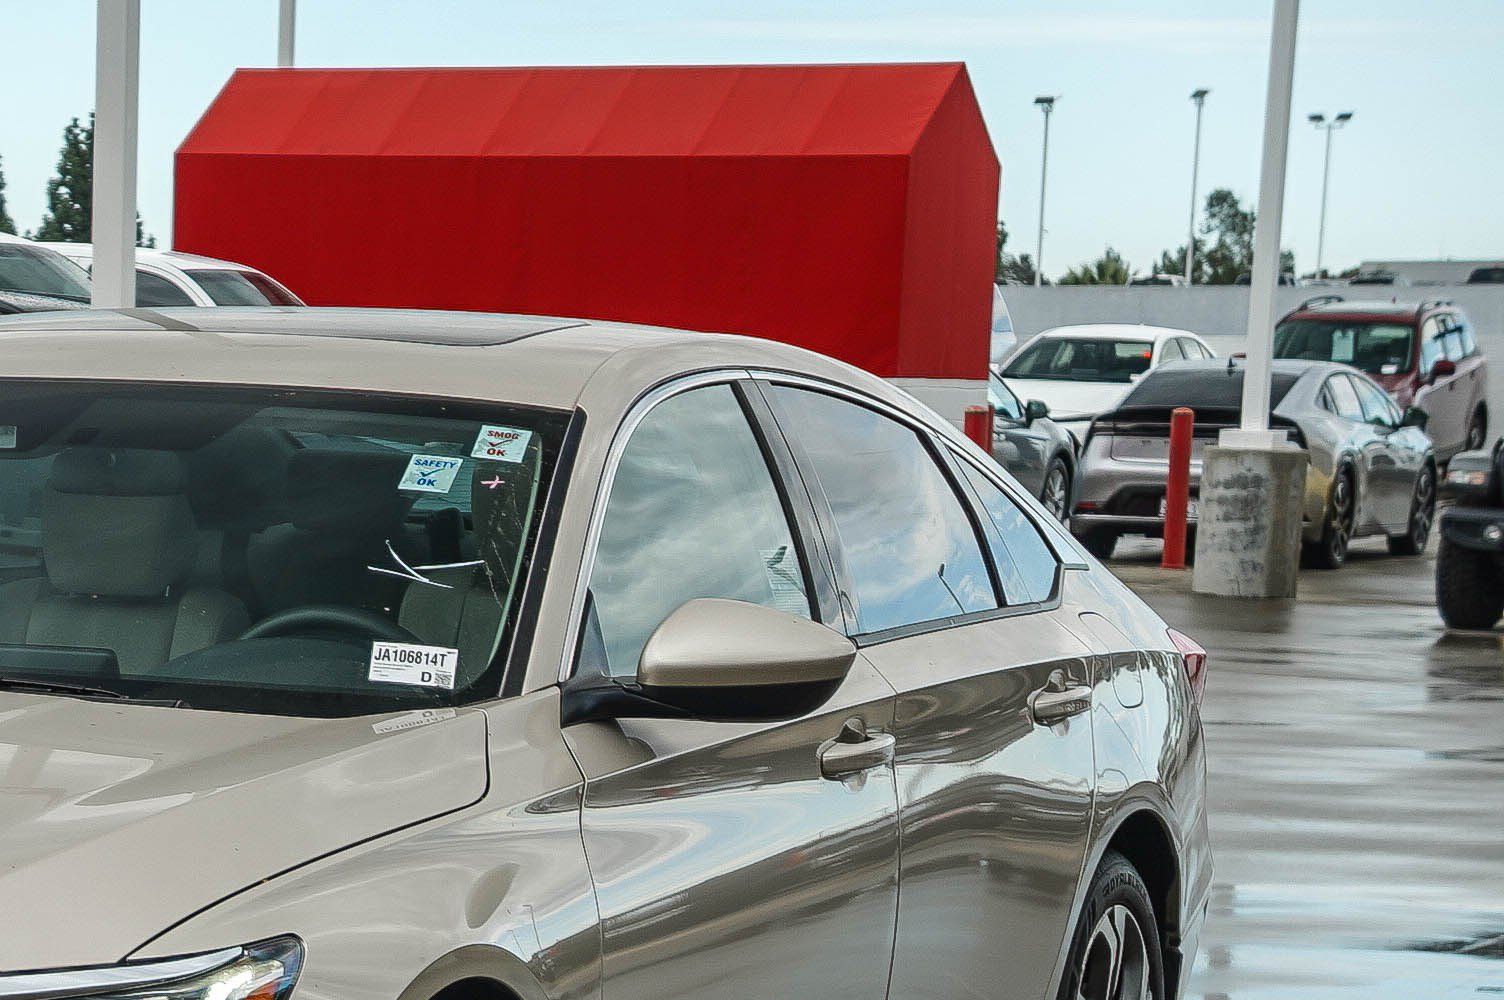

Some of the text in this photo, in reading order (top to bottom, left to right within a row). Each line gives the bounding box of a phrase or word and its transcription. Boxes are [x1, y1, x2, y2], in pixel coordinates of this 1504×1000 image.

[486, 430, 521, 440] SMOG
[486, 448, 506, 456] OK
[414, 459, 456, 469] SAFETY
[417, 478, 437, 486] OK
[374, 648, 447, 667] JA106814T
[421, 671, 432, 683] D
